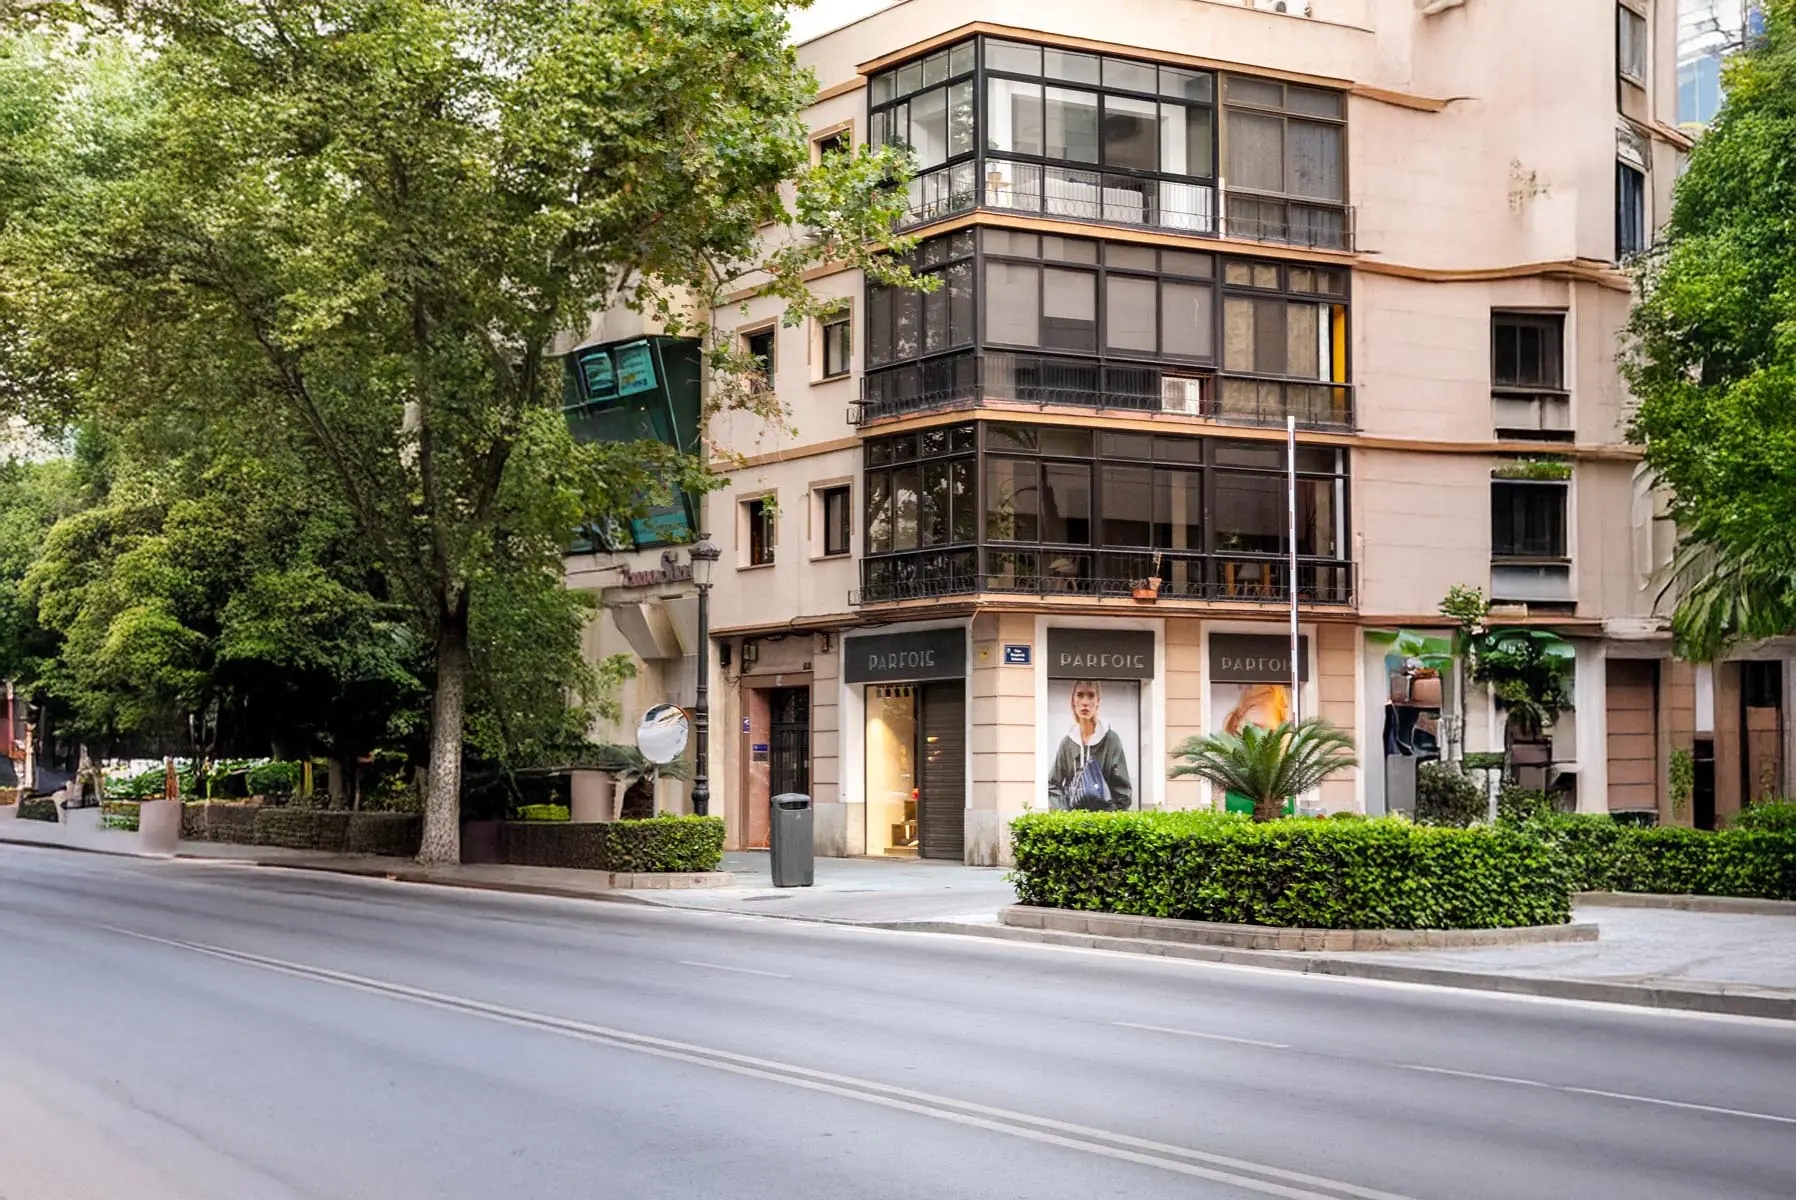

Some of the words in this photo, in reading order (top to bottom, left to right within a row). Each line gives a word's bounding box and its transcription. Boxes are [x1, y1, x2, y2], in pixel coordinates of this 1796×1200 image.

[868, 650, 935, 671] PARFOIS
[1060, 653, 1145, 668] PARFOIS
[1222, 656, 1292, 672] PARFOI
